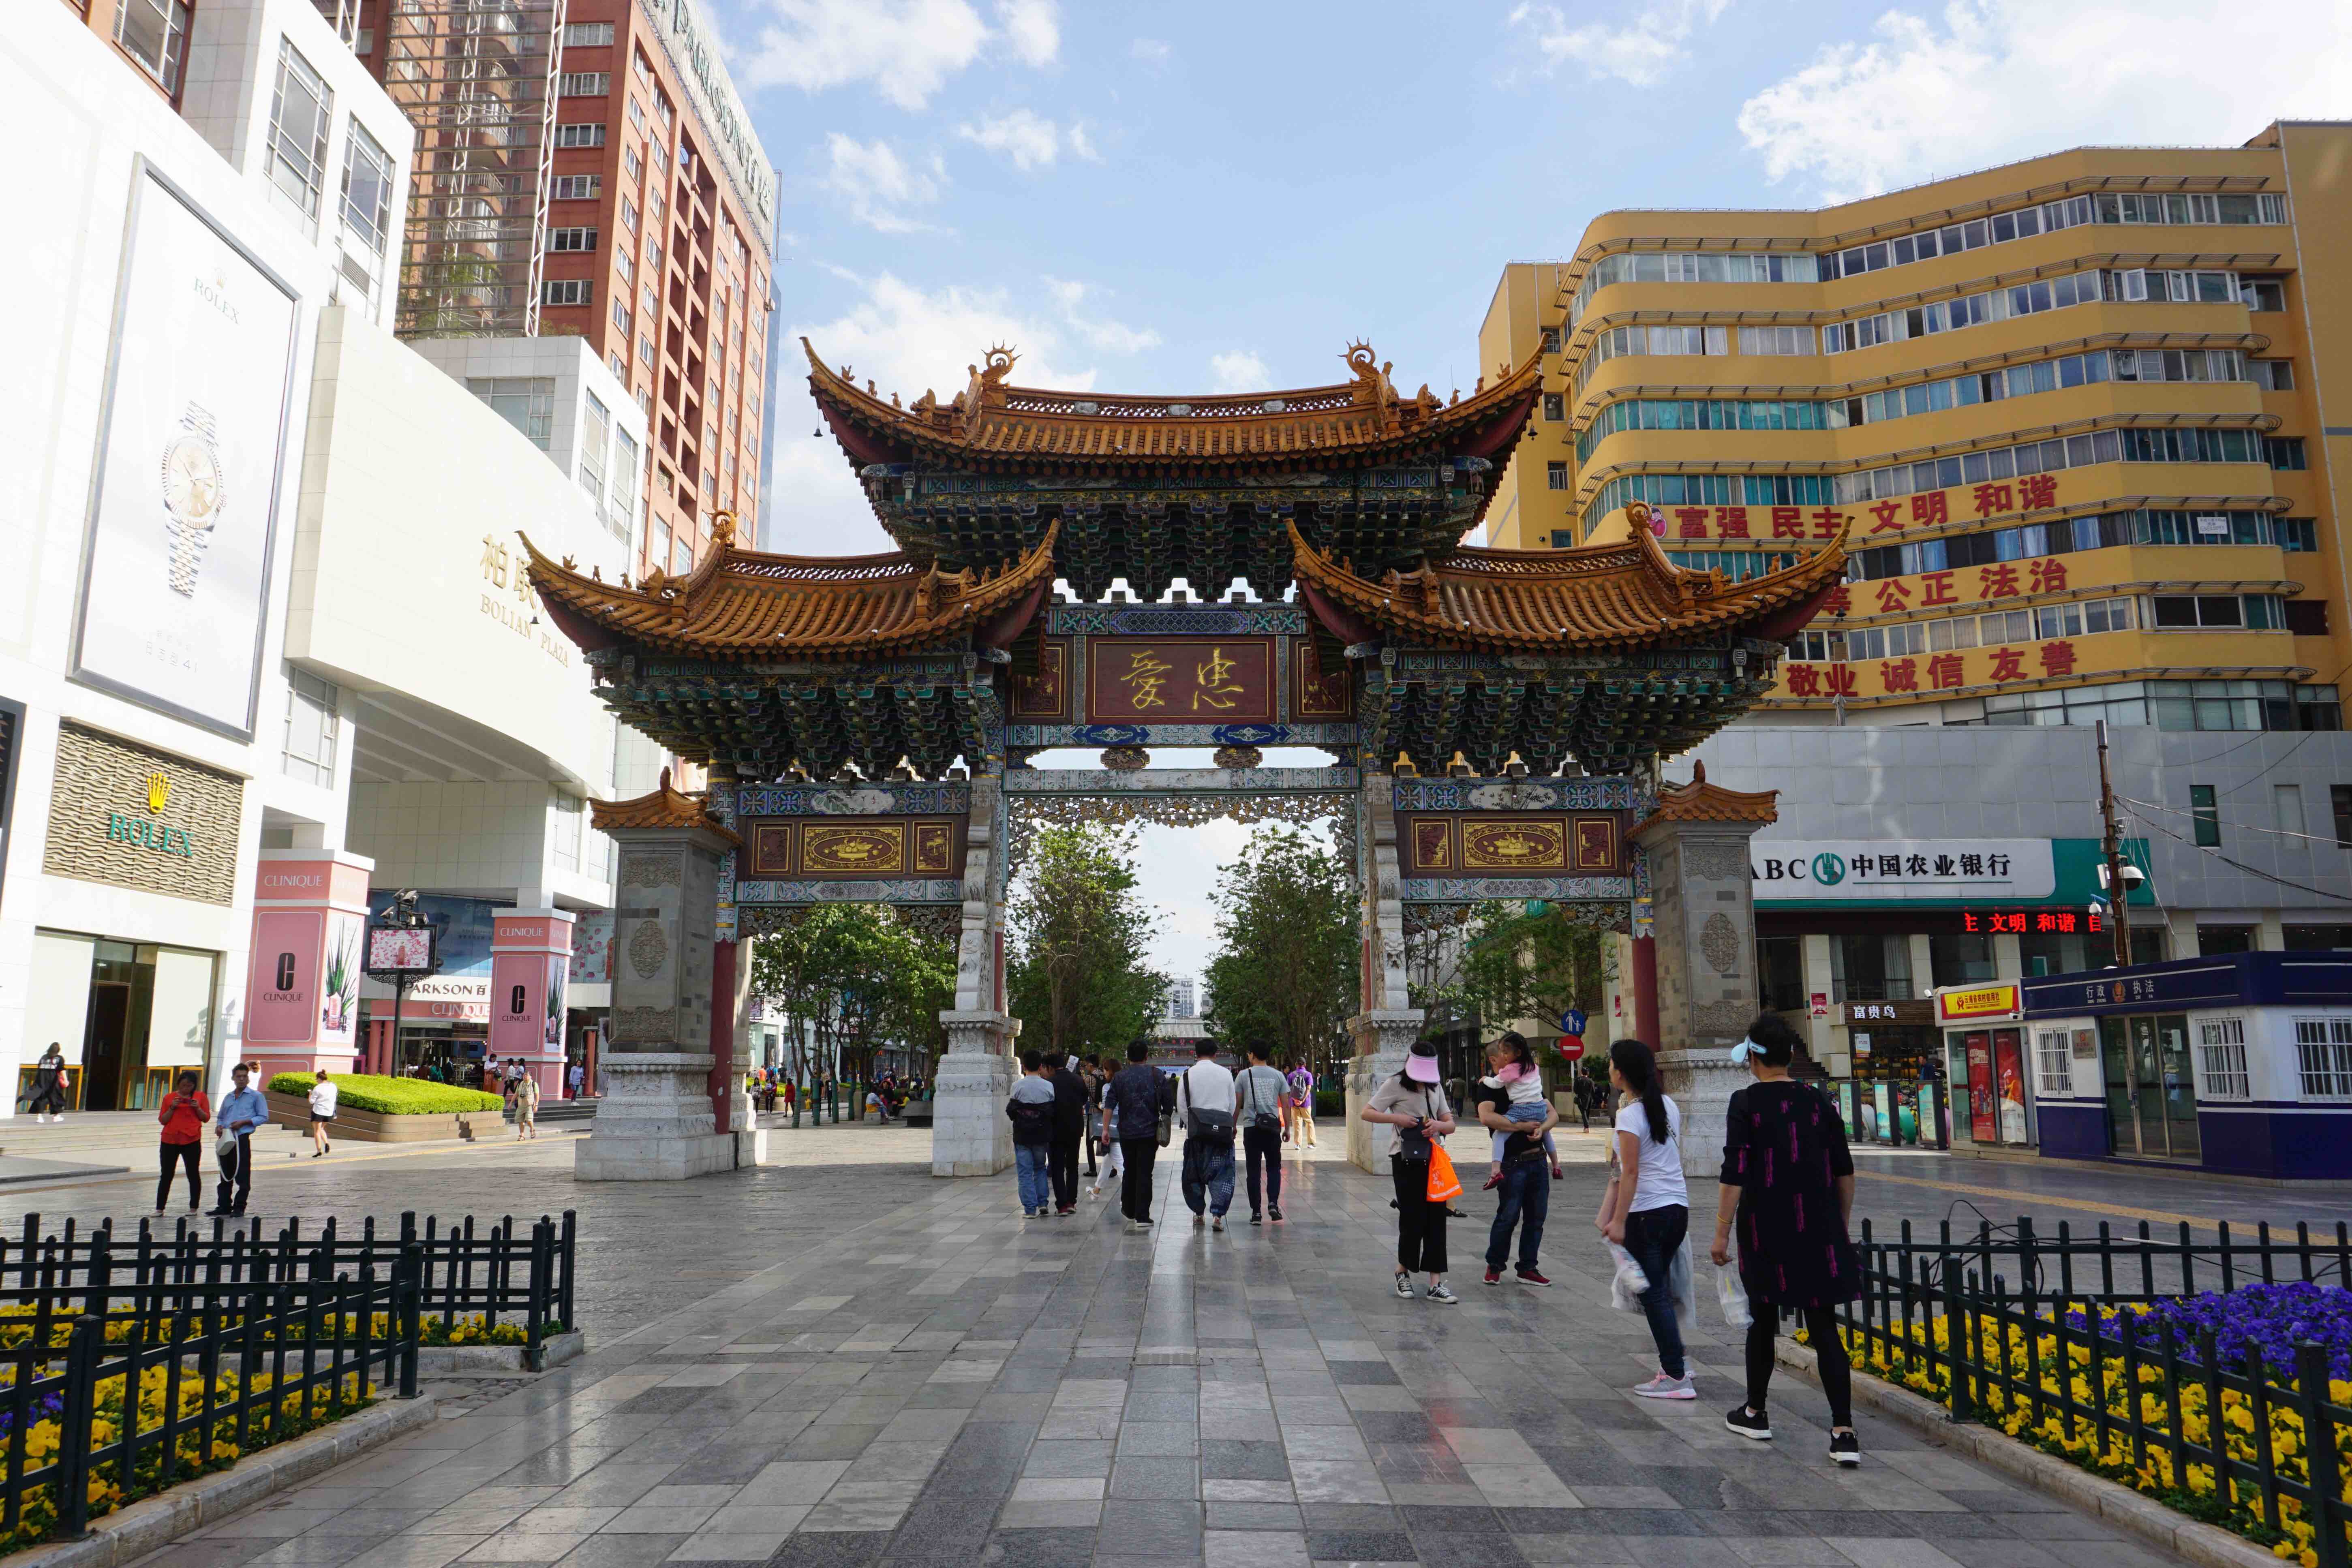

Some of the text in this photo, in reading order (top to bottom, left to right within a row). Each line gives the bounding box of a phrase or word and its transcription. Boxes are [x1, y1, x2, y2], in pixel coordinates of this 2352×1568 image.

[193, 276, 240, 325] ROLEX
[1675, 474, 2058, 539] 富强 民主 文明 和谐
[480, 534, 544, 614] 柏联
[1876, 571, 1958, 613] 公正
[1979, 558, 2067, 599] 法治
[480, 593, 568, 668] BOLIAN PLAZA
[1787, 642, 2078, 697] 敬业 诚信 友善
[107, 812, 195, 857] ROLEX
[1851, 854, 2011, 877] 中国农业银行
[265, 875, 323, 888] CLINIQUE
[500, 927, 544, 937] CLINIQUE
[1989, 913, 2026, 932] 文明
[2037, 913, 2076, 932] 和谐
[263, 993, 304, 1002] CLINIQUE
[403, 984, 473, 995] PARKSON
[2086, 979, 2154, 999] 行政 执法
[1853, 1005, 1896, 1019] 富贵鸟
